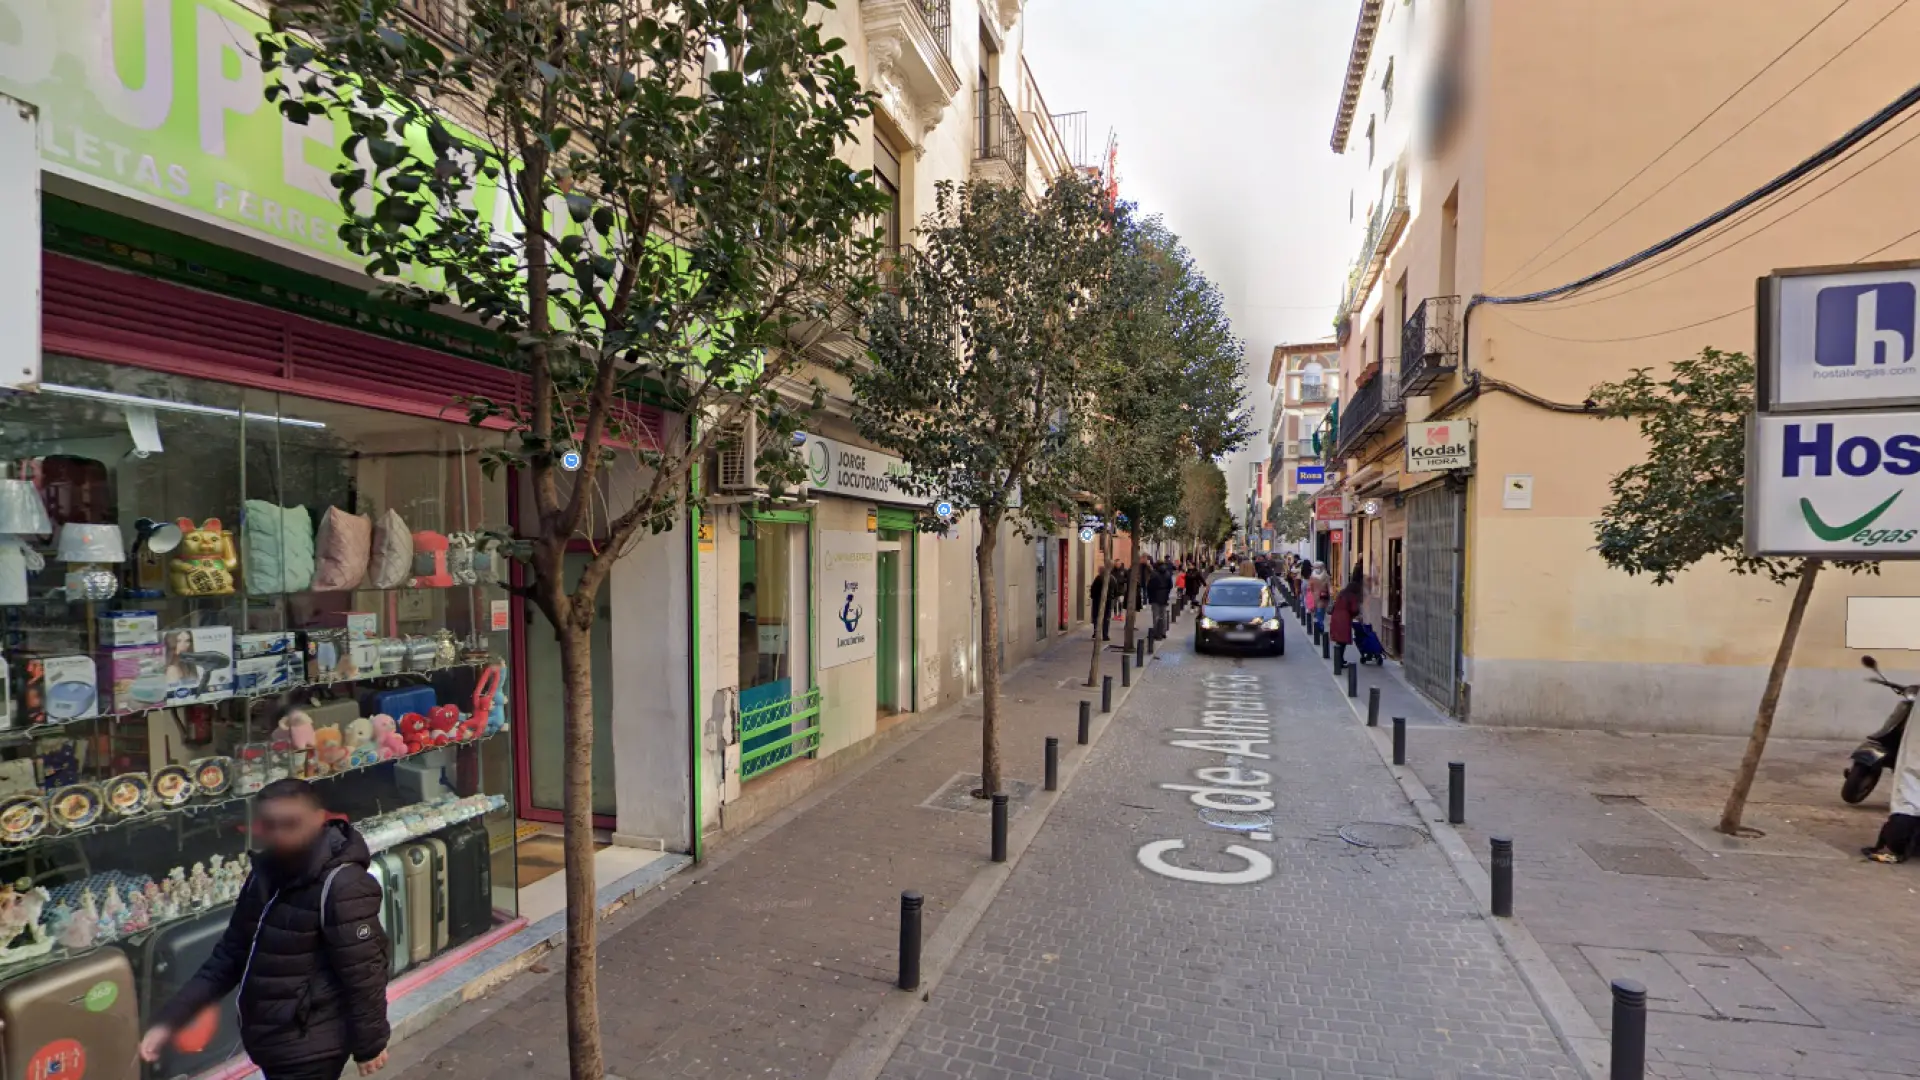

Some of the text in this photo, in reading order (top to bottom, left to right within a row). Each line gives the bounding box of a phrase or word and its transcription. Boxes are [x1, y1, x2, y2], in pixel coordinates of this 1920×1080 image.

[1813, 367, 1917, 379] hostalvegas.com
[1411, 443, 1467, 457] Kodak
[1782, 422, 1920, 478] Hos
[838, 452, 866, 470] JORGE
[1427, 457, 1459, 467] HORA
[837, 470, 889, 493] LOCUTORIOS
[843, 580, 859, 592] Jorge
